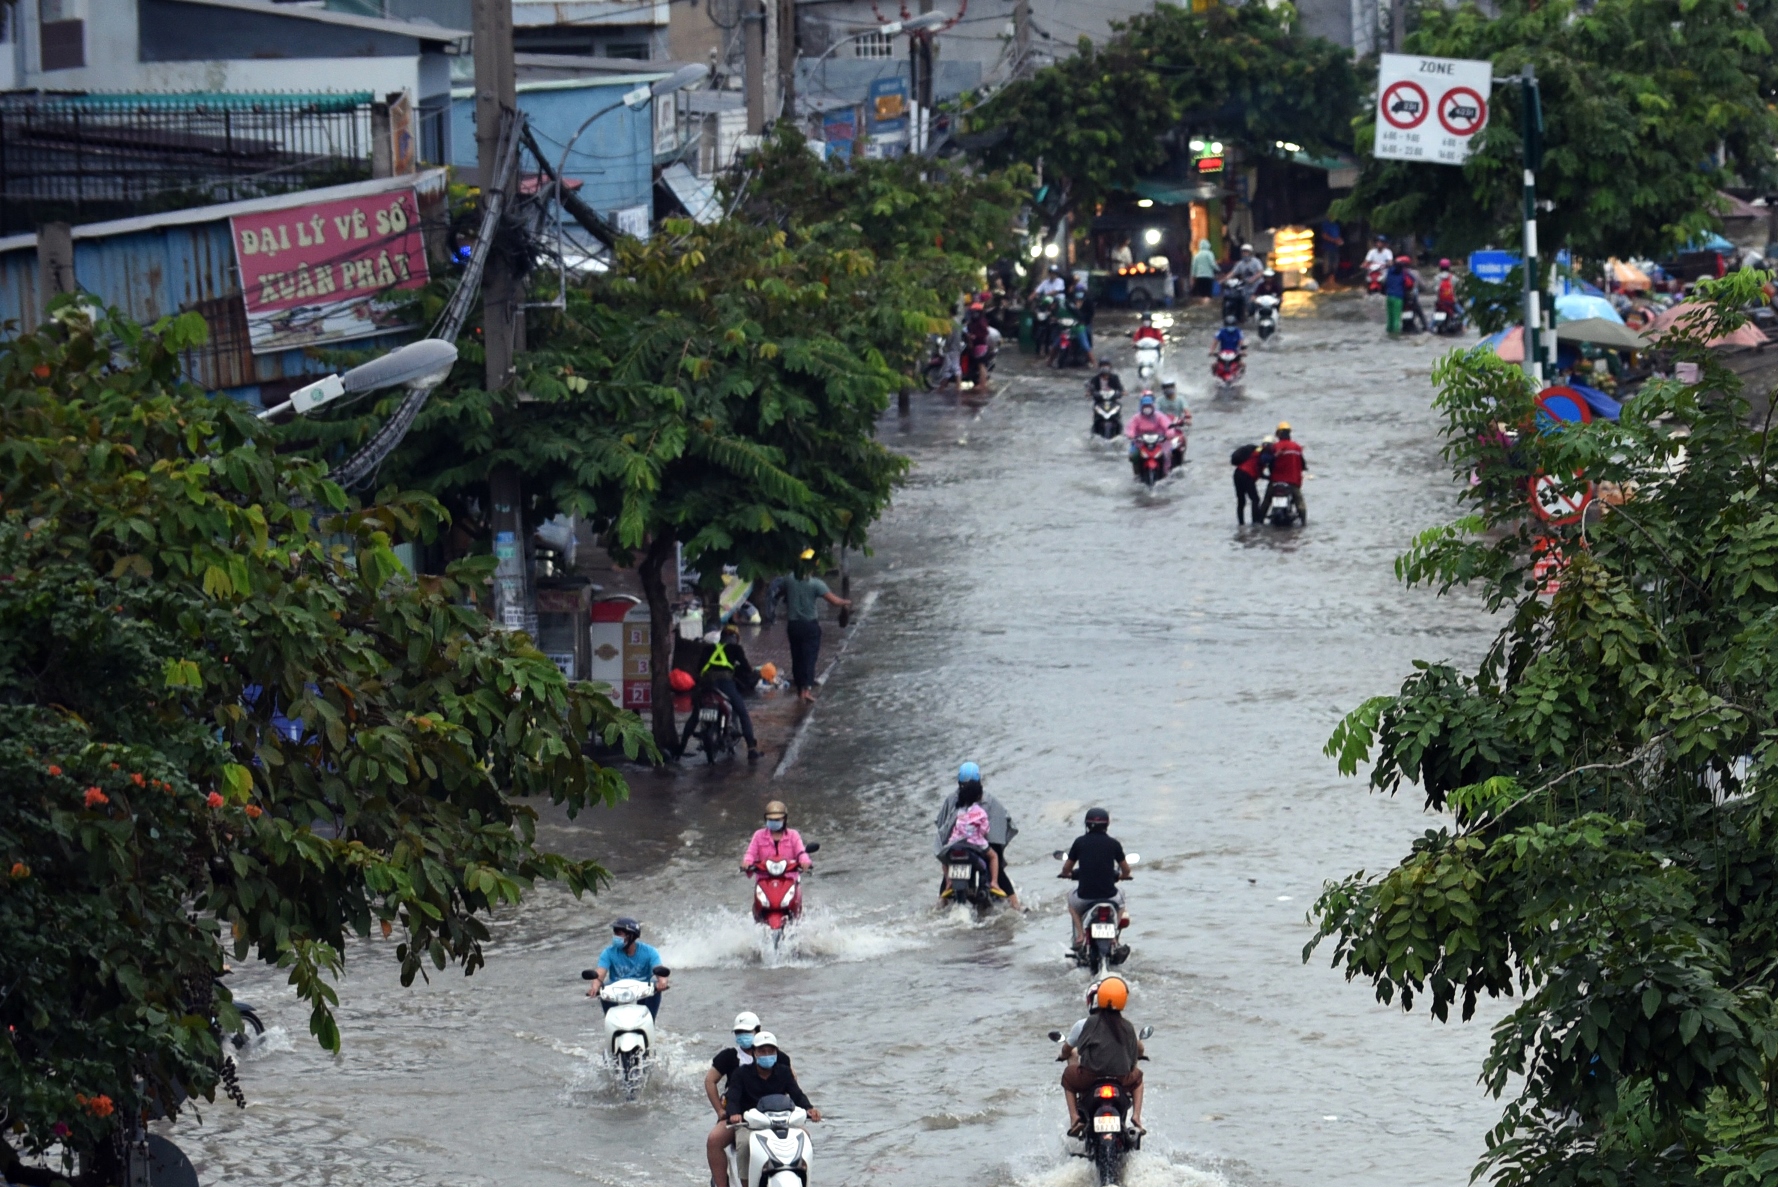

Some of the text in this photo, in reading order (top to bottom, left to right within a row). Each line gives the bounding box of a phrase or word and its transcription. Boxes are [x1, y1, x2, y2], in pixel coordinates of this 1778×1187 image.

[1419, 61, 1455, 75] ZONE
[240, 196, 408, 256] ĐẠI LÝ VÉ SỐ
[258, 250, 411, 304] XUÂN PHÁT
